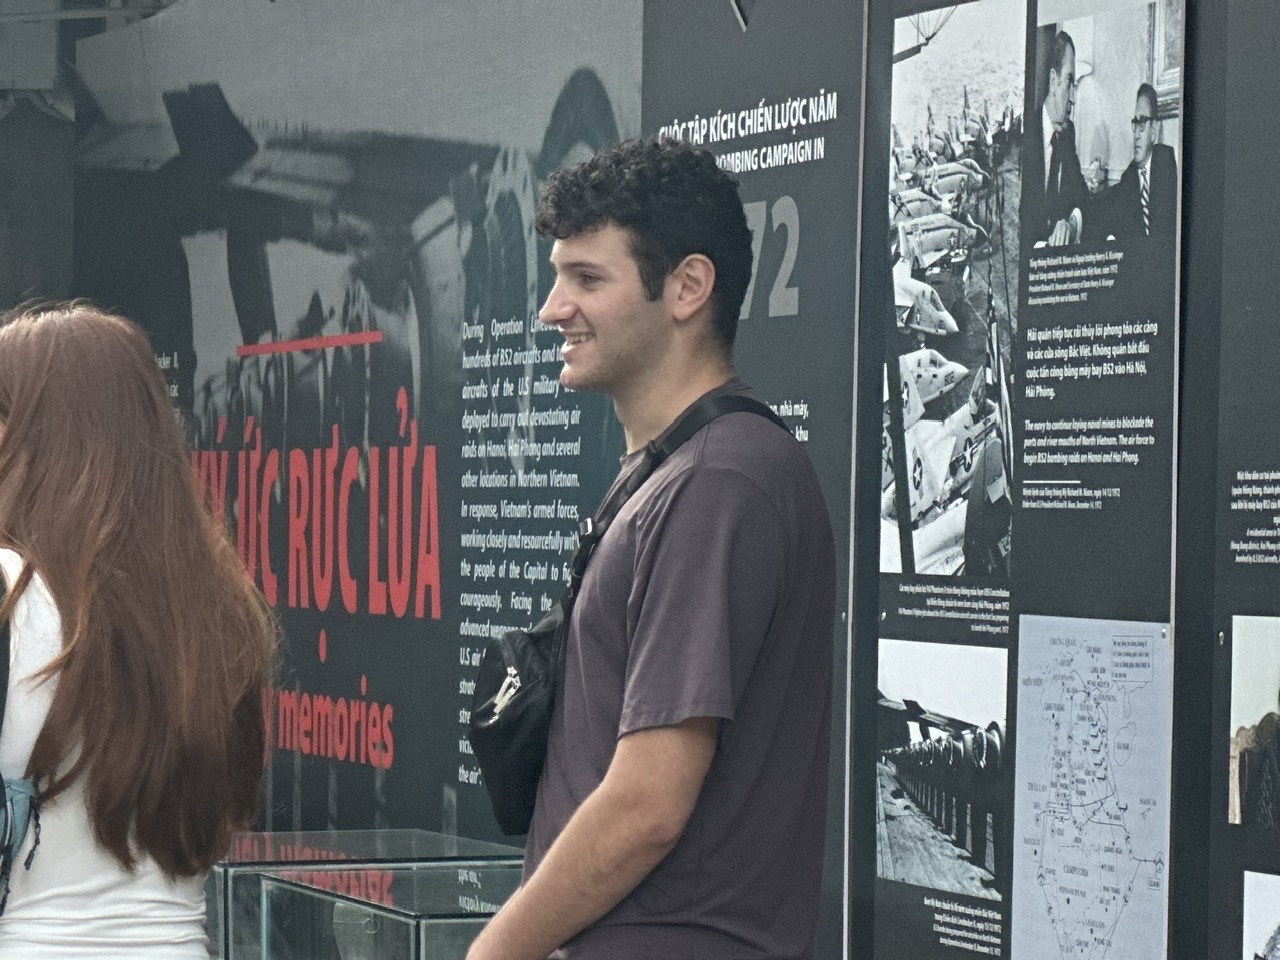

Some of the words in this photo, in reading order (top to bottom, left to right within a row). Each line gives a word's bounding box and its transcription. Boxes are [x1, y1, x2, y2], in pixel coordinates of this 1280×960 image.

[710, 110, 736, 143] KÍCH
[738, 98, 773, 138] CHIẾN
[775, 97, 807, 135] LƯỢC
[809, 88, 838, 124] NĂM
[760, 141, 812, 171] CAMPAIGN
[814, 137, 825, 160] IN
[463, 322, 484, 343] During
[491, 318, 524, 341] Operation
[463, 349, 491, 368] hundreds
[492, 348, 500, 366] of
[500, 348, 513, 366] B52
[514, 345, 541, 365] aircrafts
[542, 343, 556, 362] and
[462, 379, 488, 399] aircrafts
[492, 377, 499, 397] of
[503, 377, 514, 397] the
[533, 375, 559, 398] military
[462, 409, 490, 433] deployed
[492, 411, 498, 428] to
[499, 412, 516, 432] carry
[517, 408, 529, 428] out
[530, 406, 569, 430] devastating
[571, 405, 581, 425] air
[779, 400, 793, 417] nhà
[795, 425, 808, 442] khu
[462, 440, 477, 458] raids
[478, 443, 486, 457] on
[487, 439, 507, 459] Hanoi,
[508, 438, 520, 457] Hai
[520, 437, 541, 462] Phong
[542, 437, 556, 456] and
[556, 436, 581, 456] several
[462, 469, 478, 487] other
[480, 469, 508, 488] locations
[510, 469, 517, 487] in
[518, 468, 548, 488] Northern
[550, 468, 580, 488] Vietnam.
[368, 386, 441, 620] LỬA
[461, 499, 468, 518] In
[469, 504, 498, 522] response,
[500, 499, 532, 518] Vietnam's
[533, 499, 556, 518] armed
[558, 499, 579, 521] forces,
[461, 529, 486, 552] working
[487, 529, 507, 553] closely
[508, 530, 521, 549] and
[521, 530, 563, 555] resourcefully
[461, 558, 471, 576] the
[474, 559, 496, 581] people
[499, 559, 506, 578] of
[510, 560, 520, 578] the
[524, 561, 547, 585] Capital
[551, 564, 559, 580] to
[460, 590, 502, 613] courageously.
[511, 591, 532, 615] Facing
[541, 592, 552, 612] the
[460, 617, 490, 637] advanced
[471, 648, 481, 667] air
[278, 673, 394, 770] memories
[459, 764, 469, 783] the
